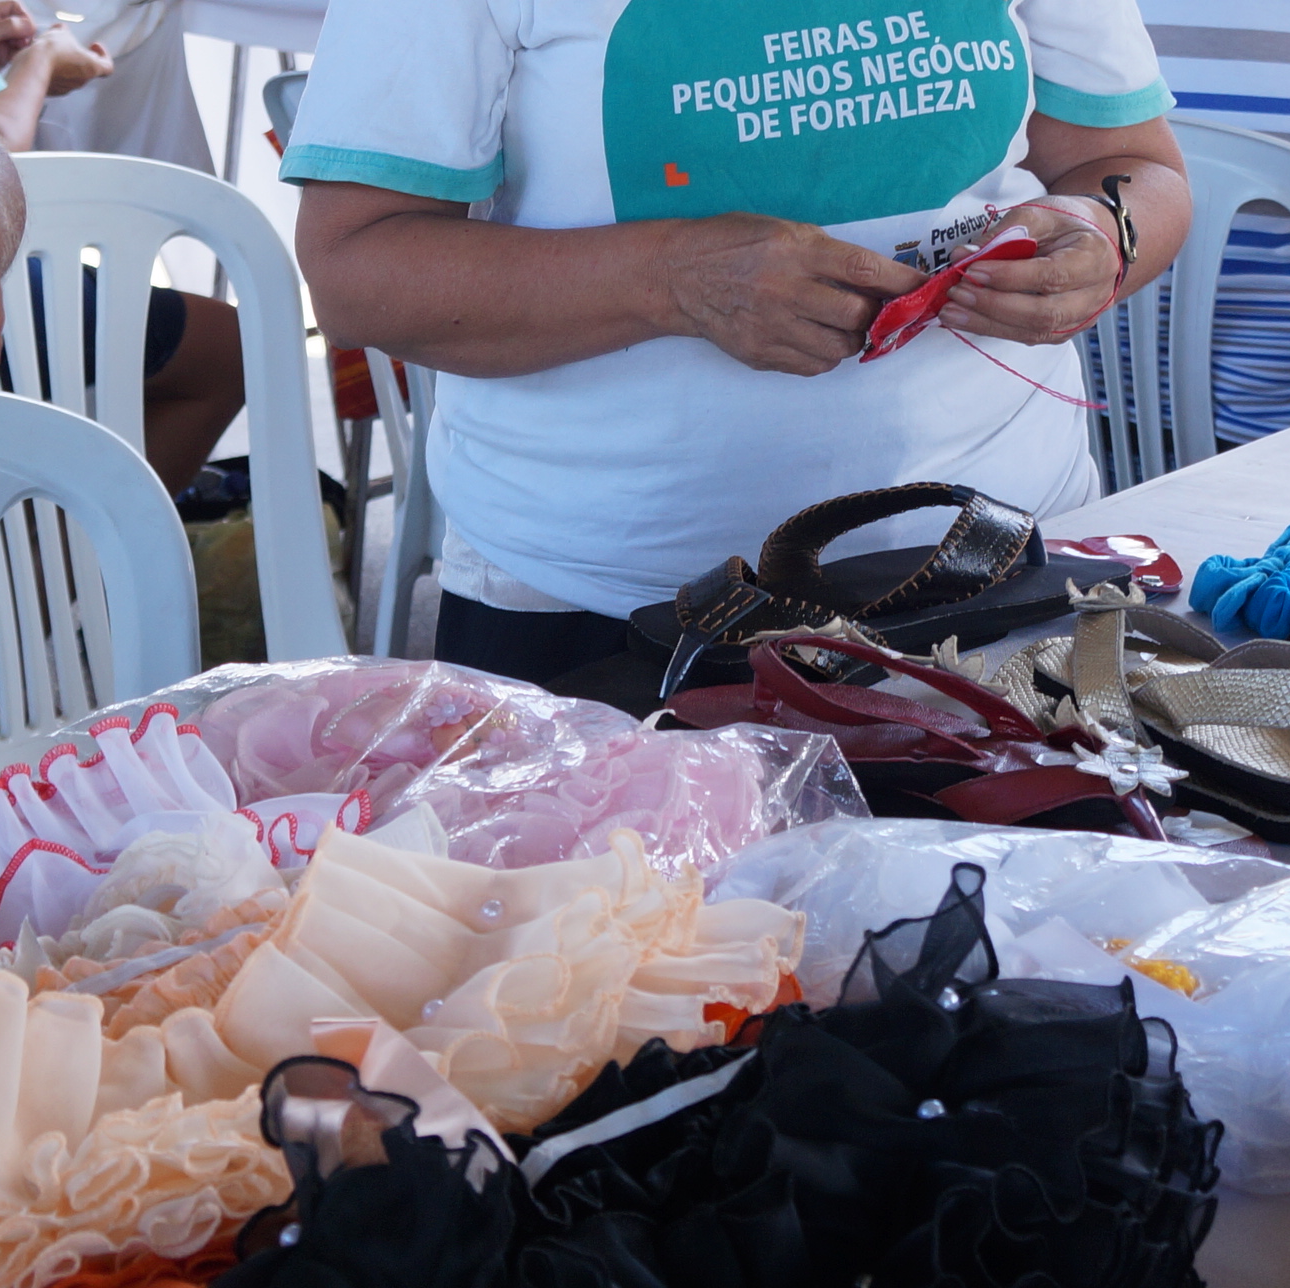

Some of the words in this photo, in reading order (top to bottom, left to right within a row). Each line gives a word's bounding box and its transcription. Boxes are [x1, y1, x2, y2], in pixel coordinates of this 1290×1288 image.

[763, 20, 877, 64] FEIRAS
[884, 11, 930, 44] DE
[672, 60, 852, 114] PEQUENOS
[861, 36, 1015, 87] NEGÓCIOS
[736, 109, 781, 143] DE
[790, 78, 976, 136] FORTALEZA
